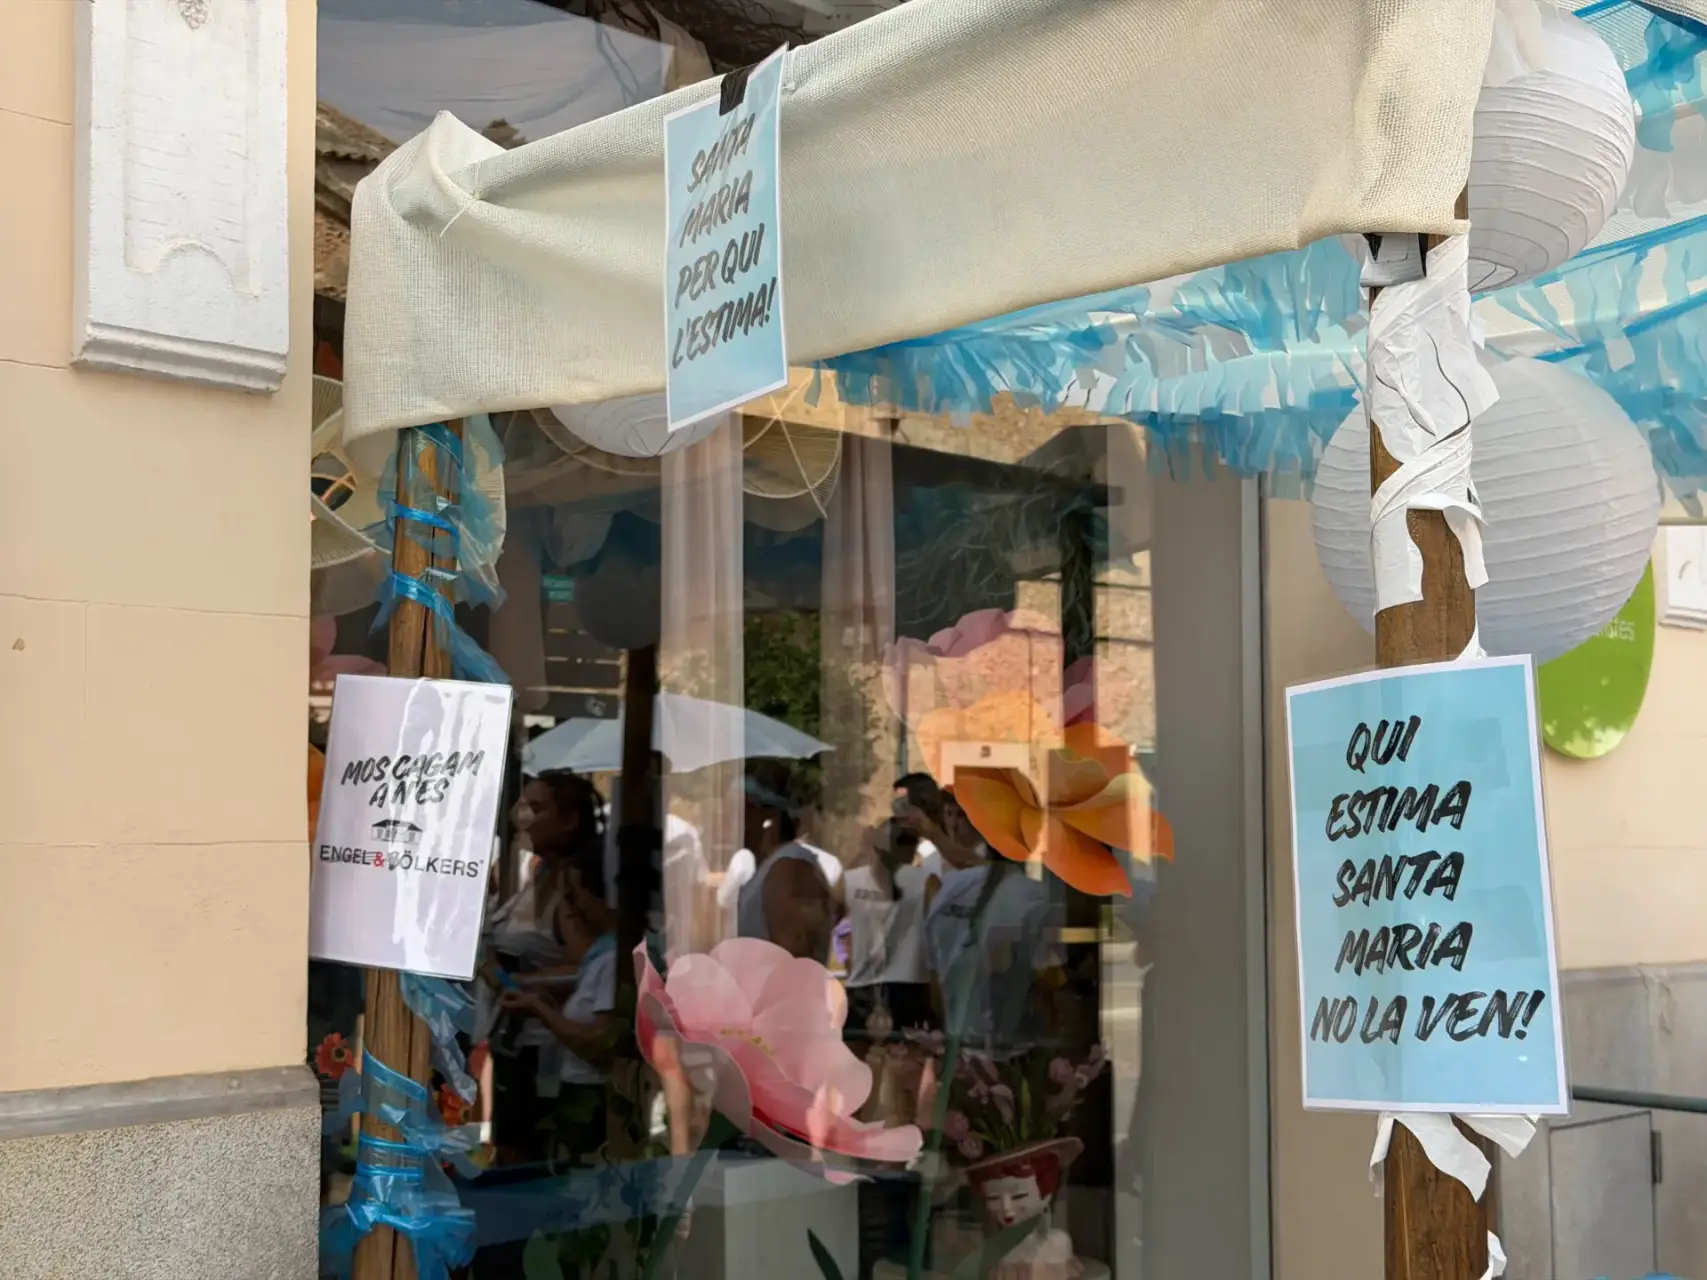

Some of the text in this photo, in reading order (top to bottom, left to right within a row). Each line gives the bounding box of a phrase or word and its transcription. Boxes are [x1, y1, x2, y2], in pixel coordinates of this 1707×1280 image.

[687, 112, 756, 193] SANTA
[679, 169, 753, 249] MARIA
[674, 222, 765, 309] PER QUI
[672, 276, 777, 369] L'ESTIMA!
[340, 750, 486, 786] MOS CAGAM
[1346, 715, 1421, 774] QUI
[1325, 780, 1472, 842] ESTIMA
[1332, 851, 1465, 908] SANTA
[1334, 922, 1473, 975] MARIA
[1310, 989, 1546, 1046] NO LA VEN!
